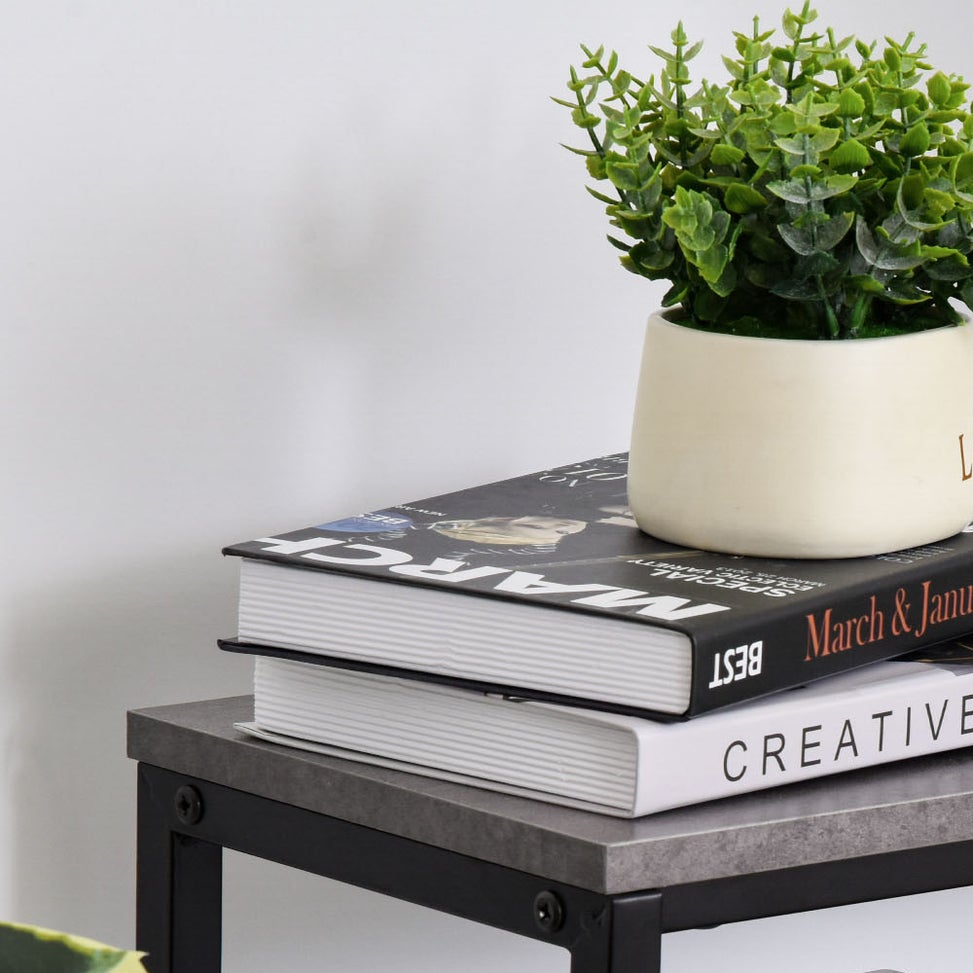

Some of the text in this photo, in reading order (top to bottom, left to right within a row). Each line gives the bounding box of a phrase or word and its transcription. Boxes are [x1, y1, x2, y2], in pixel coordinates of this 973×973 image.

[626, 558, 815, 592] ECLECTIC VARIETY
[649, 568, 796, 598] SPECIAL
[804, 595, 884, 662] March
[891, 587, 912, 636] &
[708, 640, 764, 689] BEST
